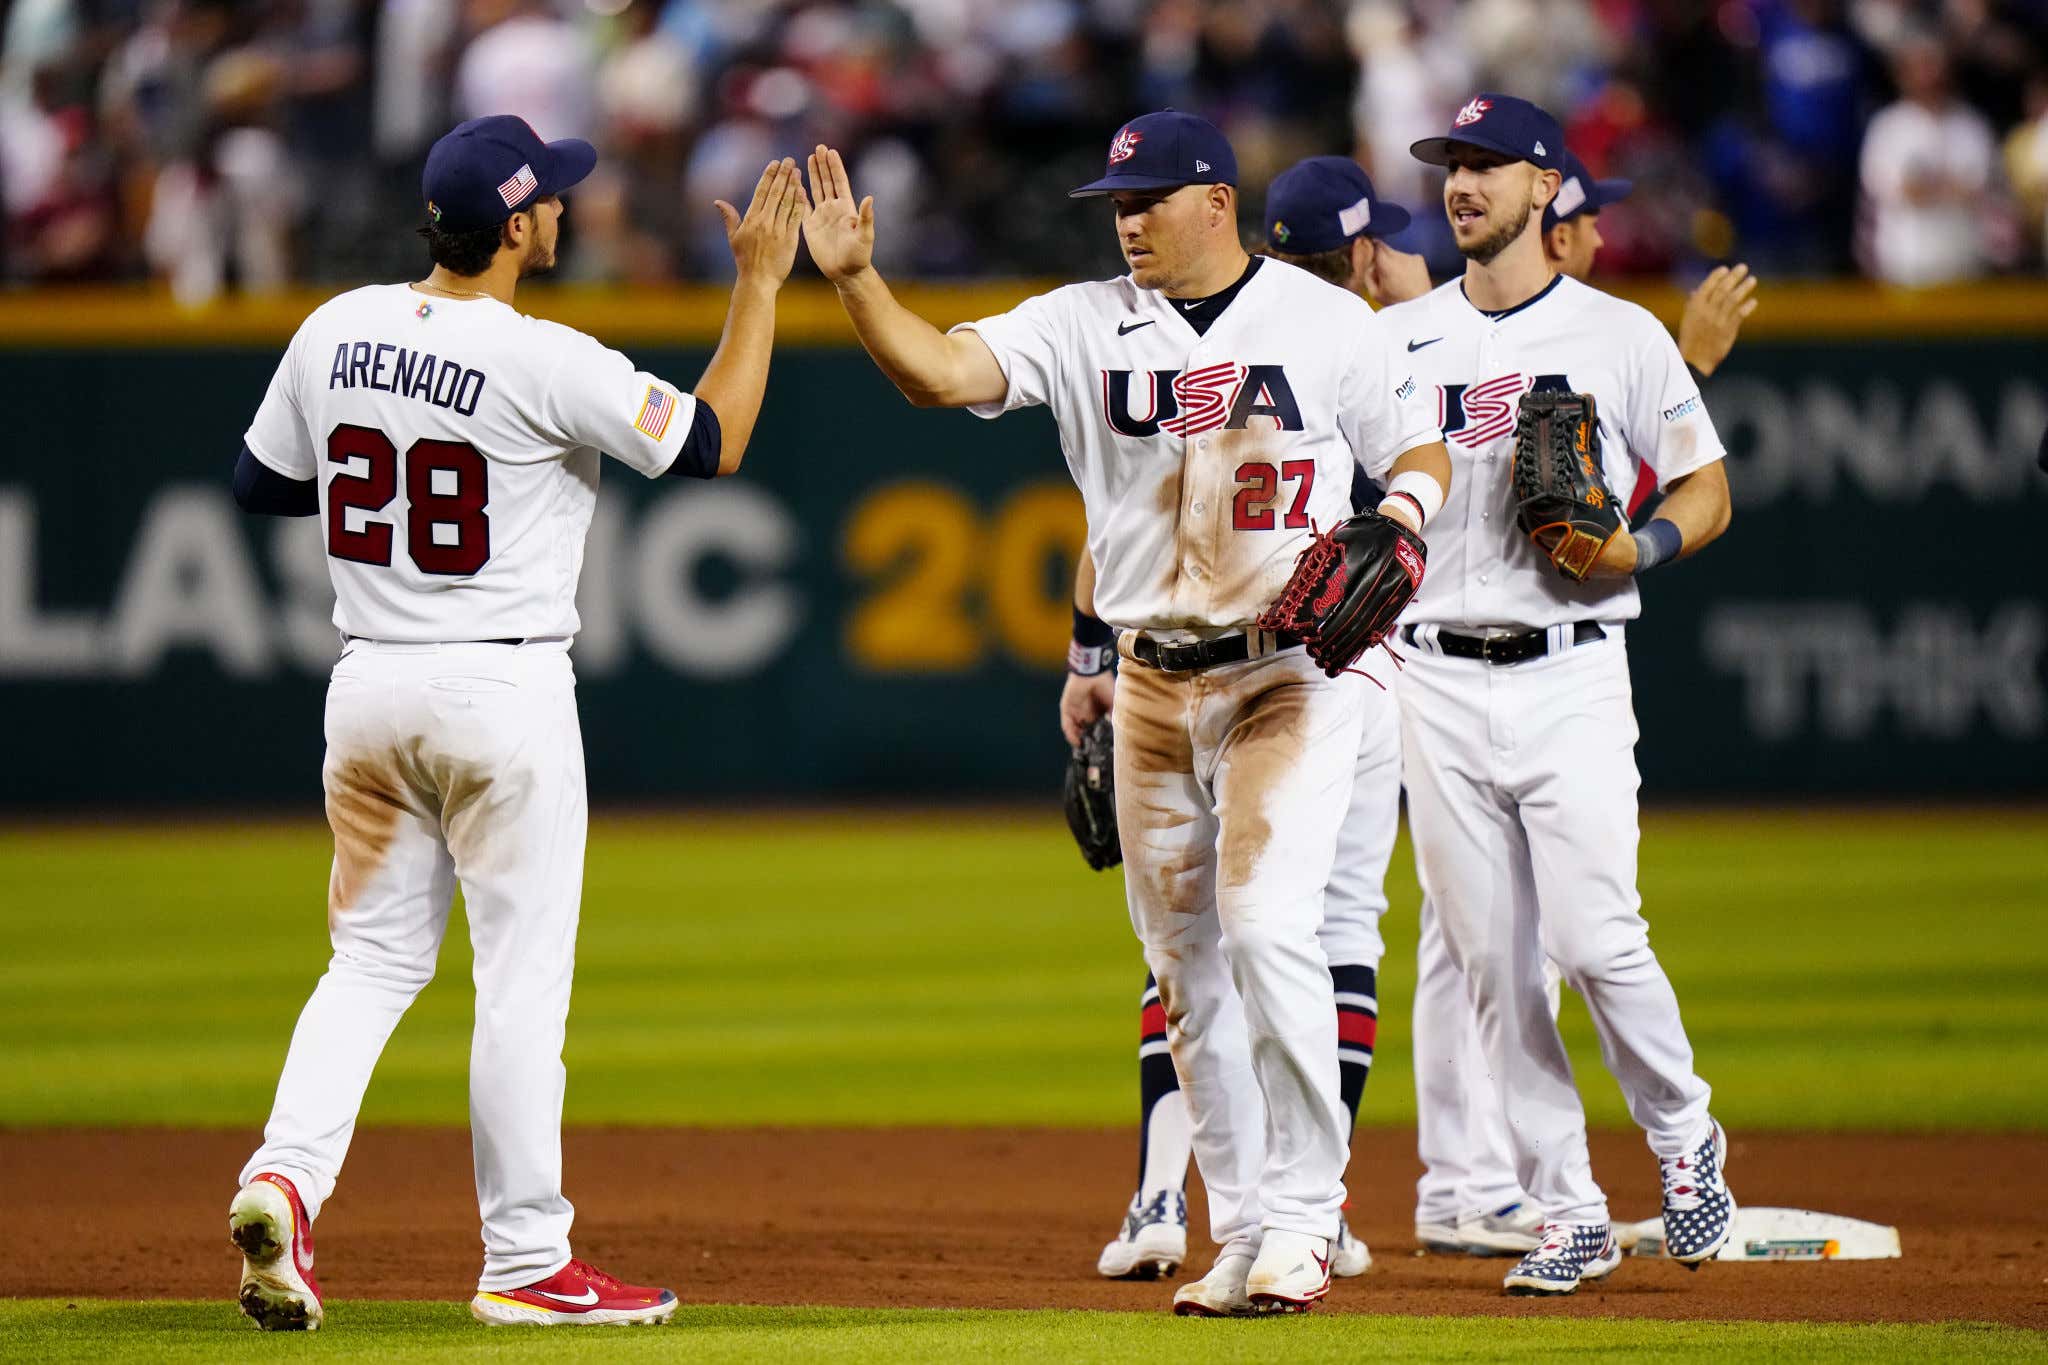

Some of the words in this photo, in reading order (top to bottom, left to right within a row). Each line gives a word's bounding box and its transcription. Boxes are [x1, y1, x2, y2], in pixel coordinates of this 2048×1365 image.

[329, 341, 486, 417] ARENADO
[1101, 361, 1304, 438] USA
[327, 422, 490, 576] 28
[1232, 458, 1316, 531] 27
[1586, 486, 1606, 509] 30
